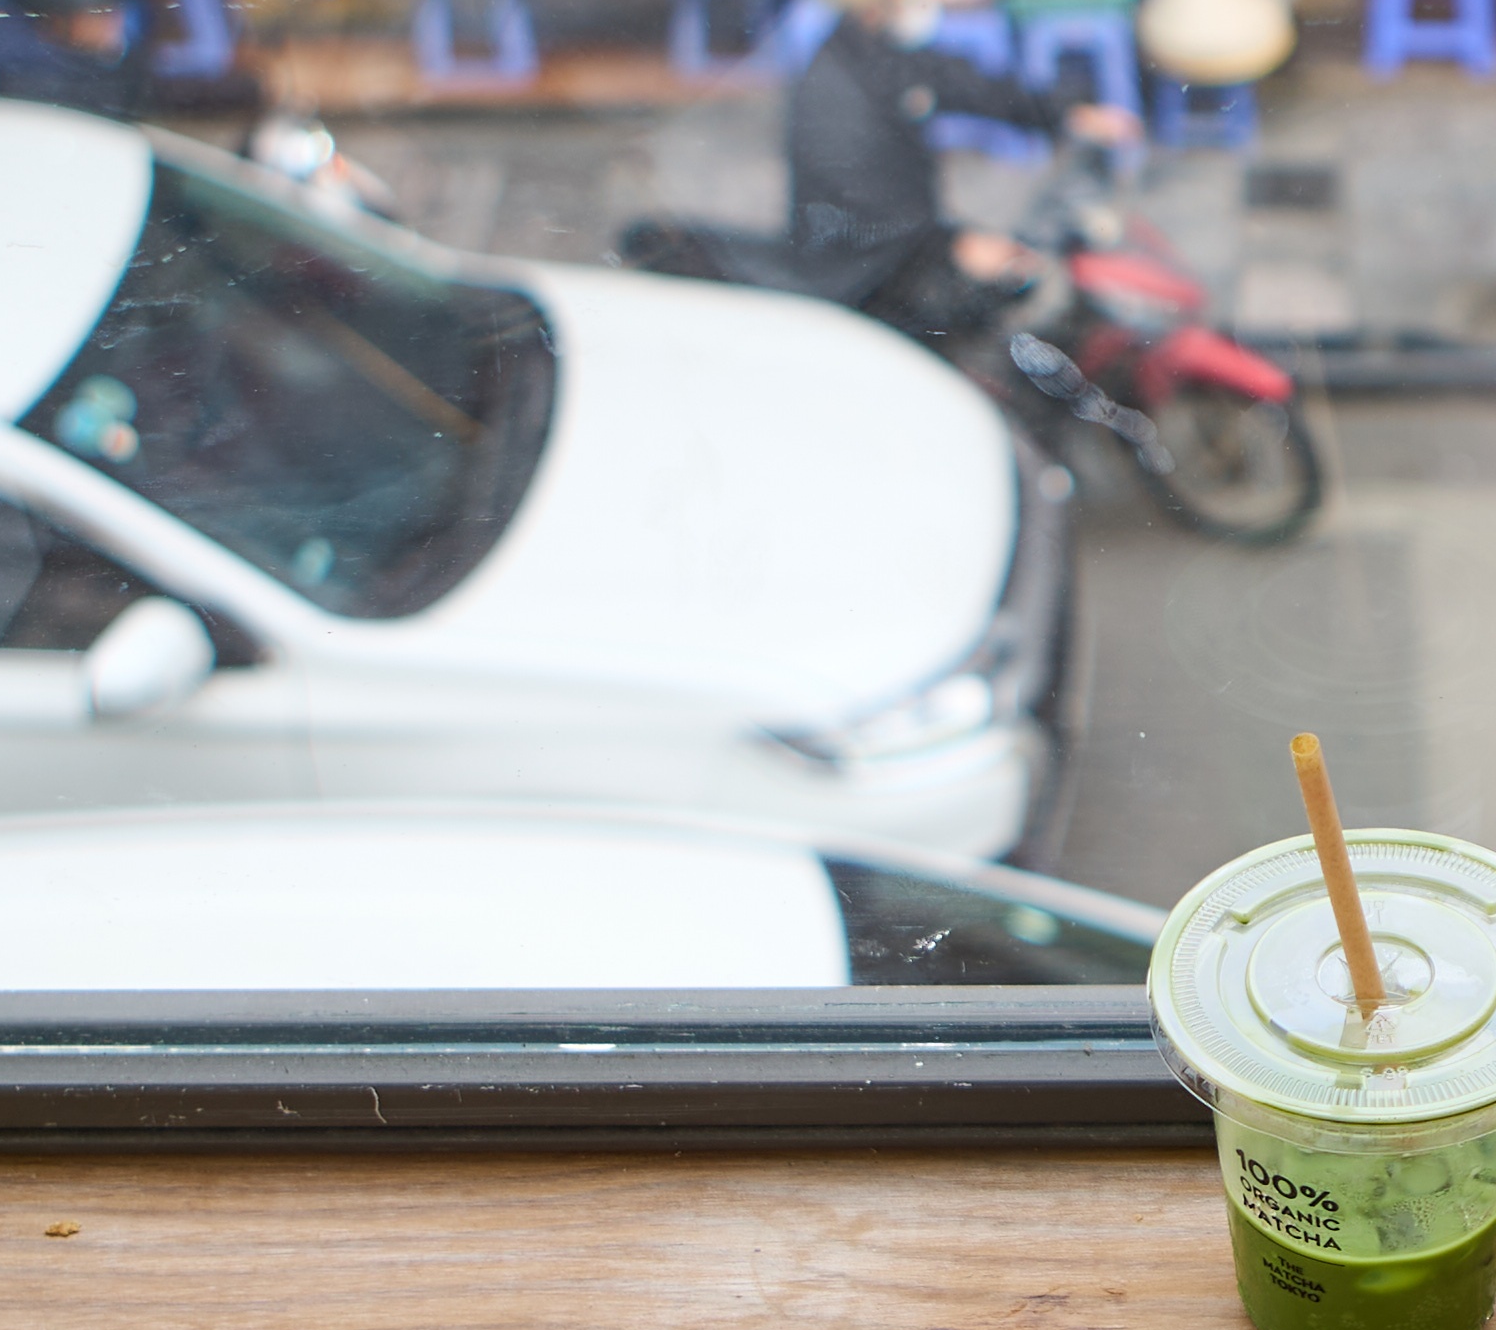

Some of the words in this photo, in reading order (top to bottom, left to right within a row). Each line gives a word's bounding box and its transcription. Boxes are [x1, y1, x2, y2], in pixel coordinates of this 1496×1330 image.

[1235, 1149, 1339, 1212] 100%
[1240, 1175, 1341, 1232] ORGANIC
[1242, 1193, 1342, 1251] MATCHA
[1262, 1257, 1326, 1294] MATCHA
[1269, 1272, 1321, 1303] TOKYO
[1278, 1255, 1304, 1275] THE
